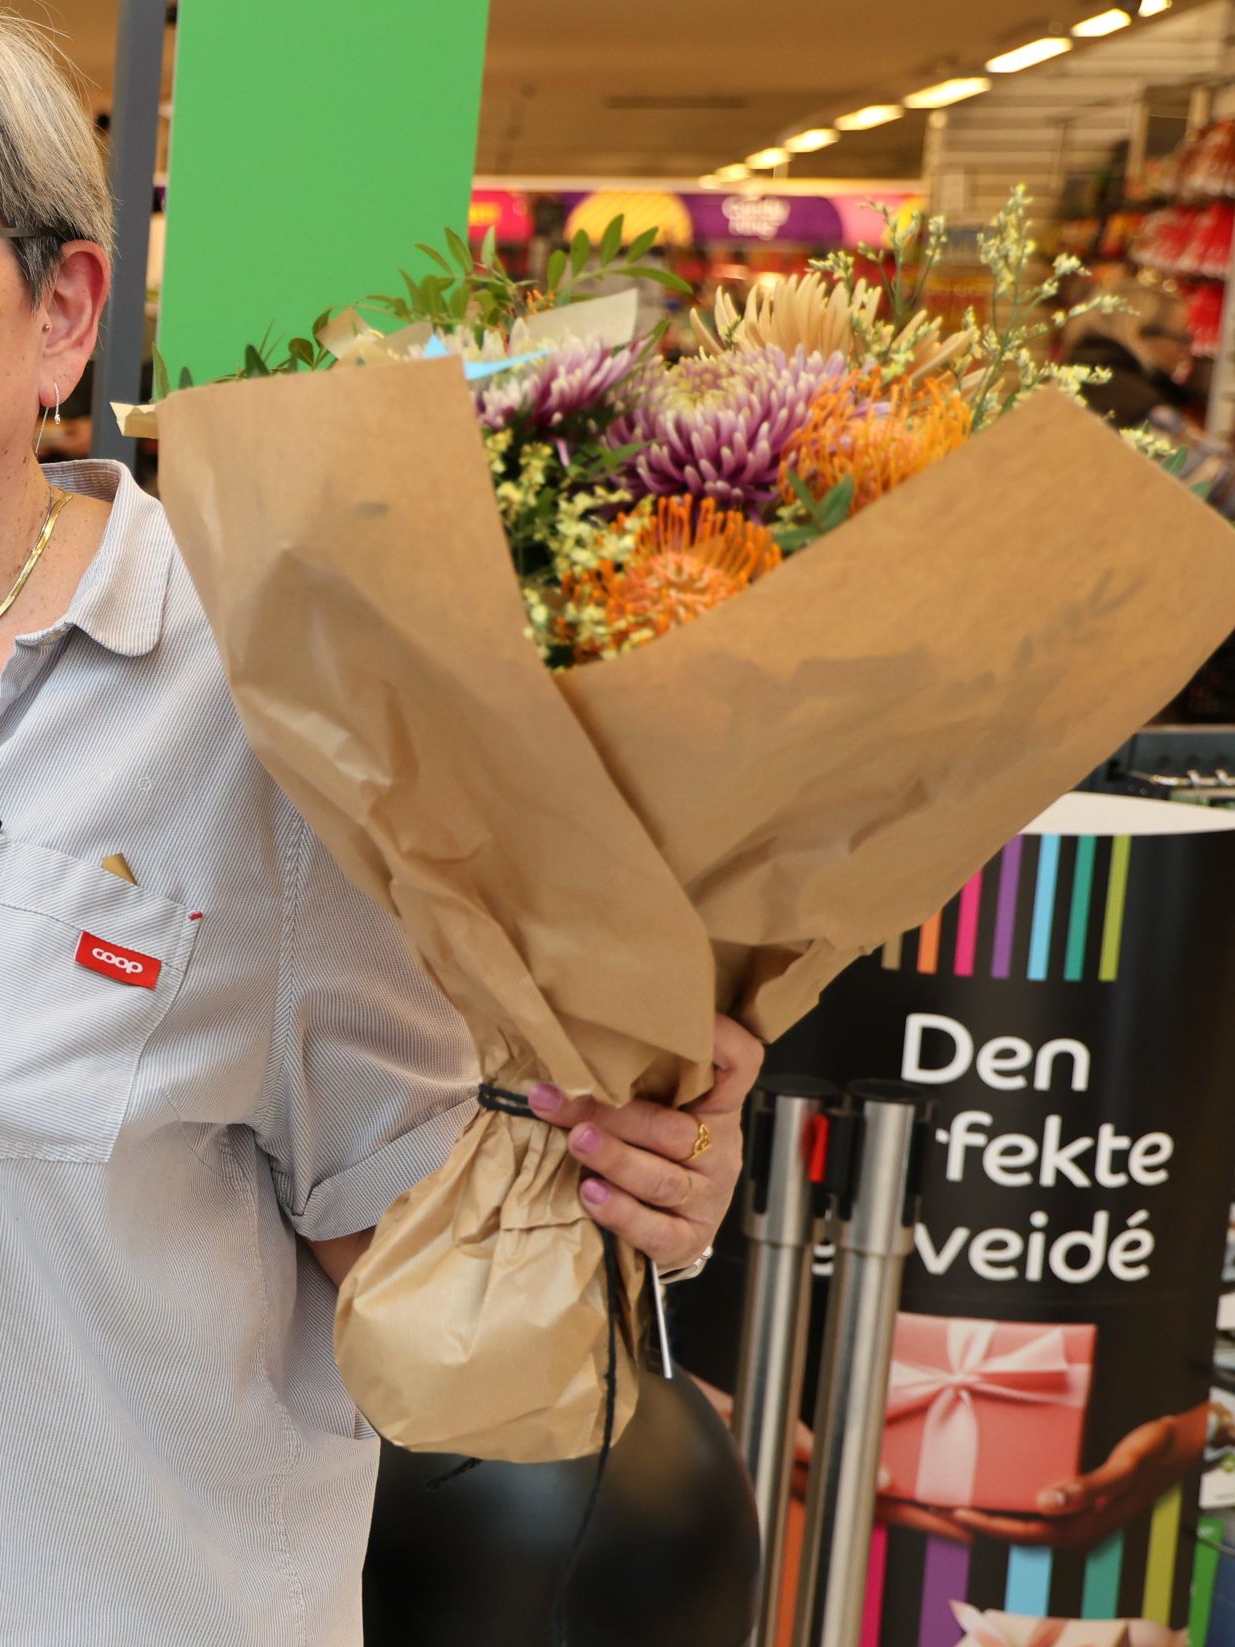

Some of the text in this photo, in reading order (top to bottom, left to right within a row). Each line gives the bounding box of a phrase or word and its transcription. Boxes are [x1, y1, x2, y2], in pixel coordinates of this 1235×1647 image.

[92, 947, 143, 974] coop
[900, 1012, 1090, 1092] Den
[935, 1110, 1174, 1189] fekte
[914, 1209, 1155, 1284] veidé
